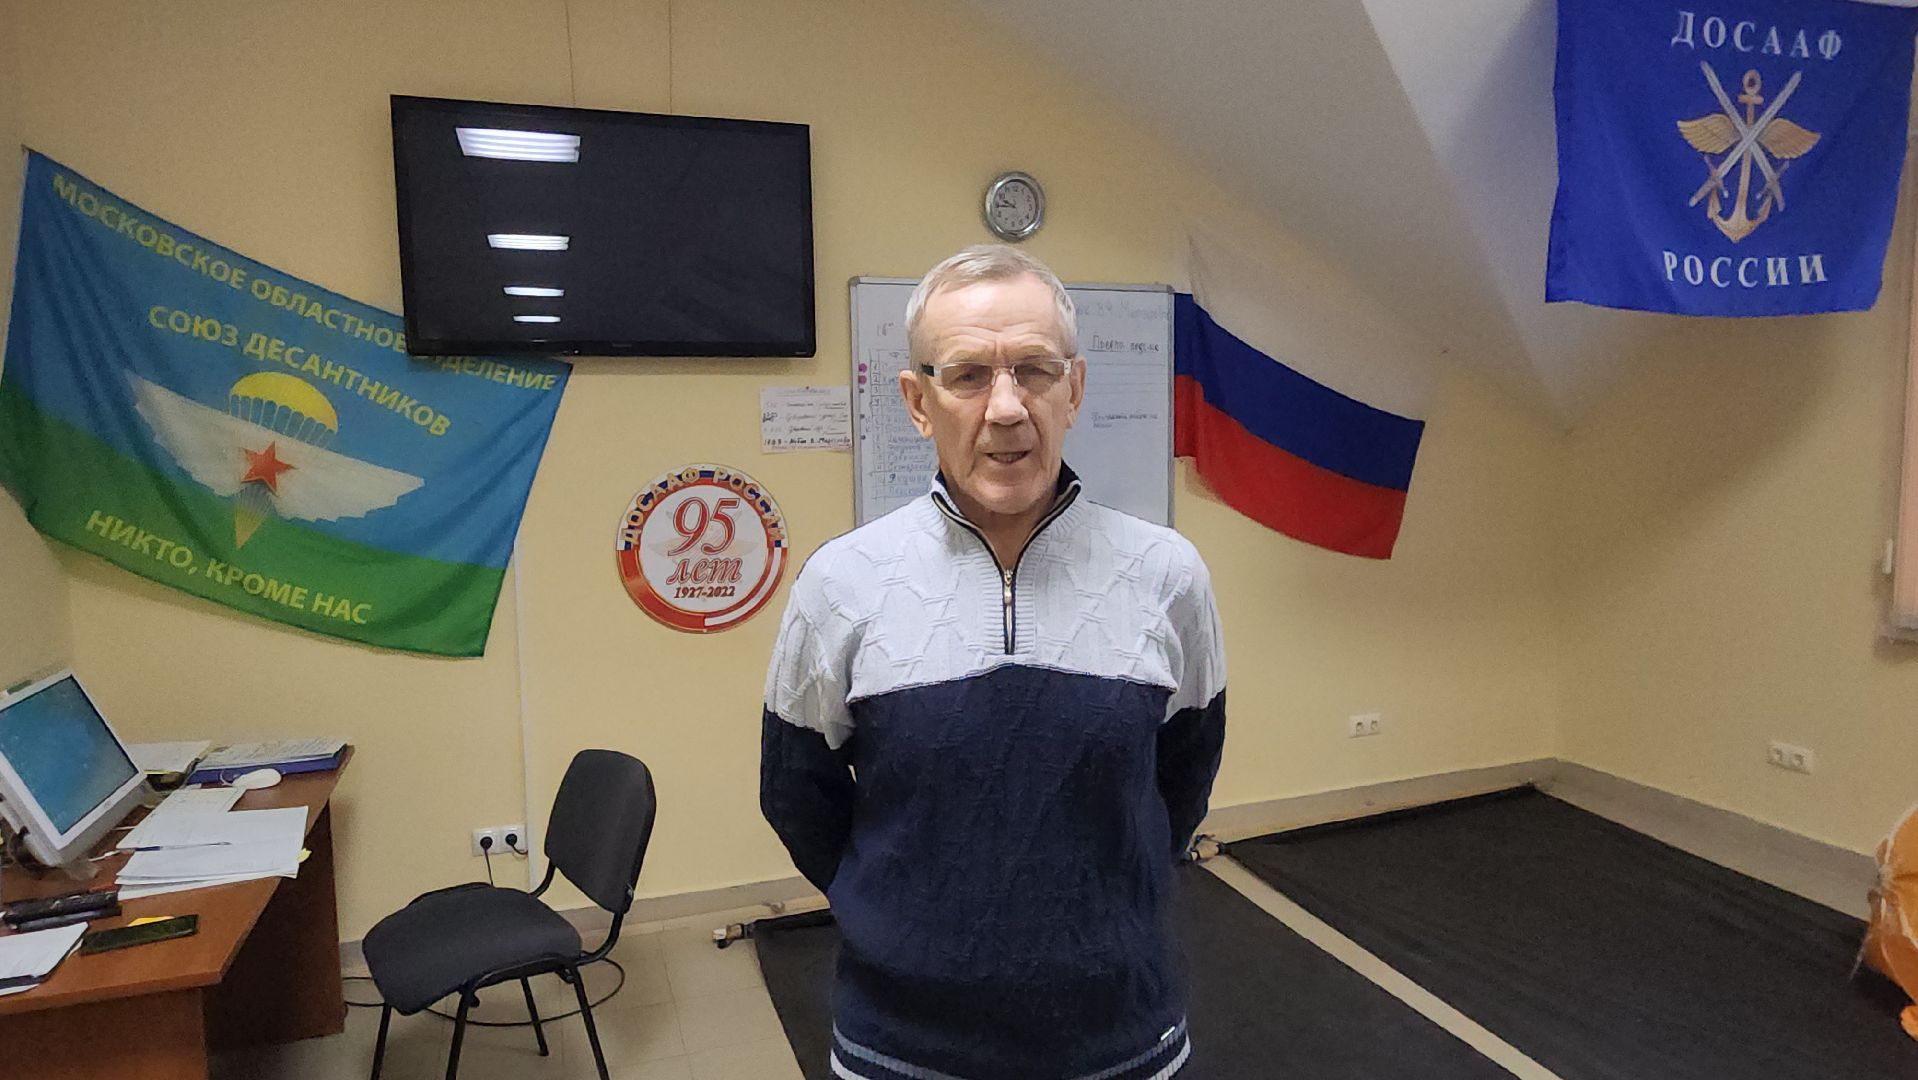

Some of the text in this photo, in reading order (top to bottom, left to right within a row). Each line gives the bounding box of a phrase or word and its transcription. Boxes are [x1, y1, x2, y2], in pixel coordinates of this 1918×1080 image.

[1671, 11, 1842, 60] ДОСААФ
[52, 173, 558, 391] МОСКОВСКОЕ ОБЛАСТНОЕ ДЕЛЕНИЕ
[1663, 251, 1828, 288] РОССИИ
[149, 306, 451, 437] СОЮЗ ДЕСАНТНИКОВ
[621, 468, 786, 546] ДОСААФ РОССИИ
[667, 497, 741, 556] 95
[85, 510, 372, 626] НИКТО, КРОМЕ НАС
[666, 557, 743, 585] лет
[673, 586, 736, 599] 1927-2022
